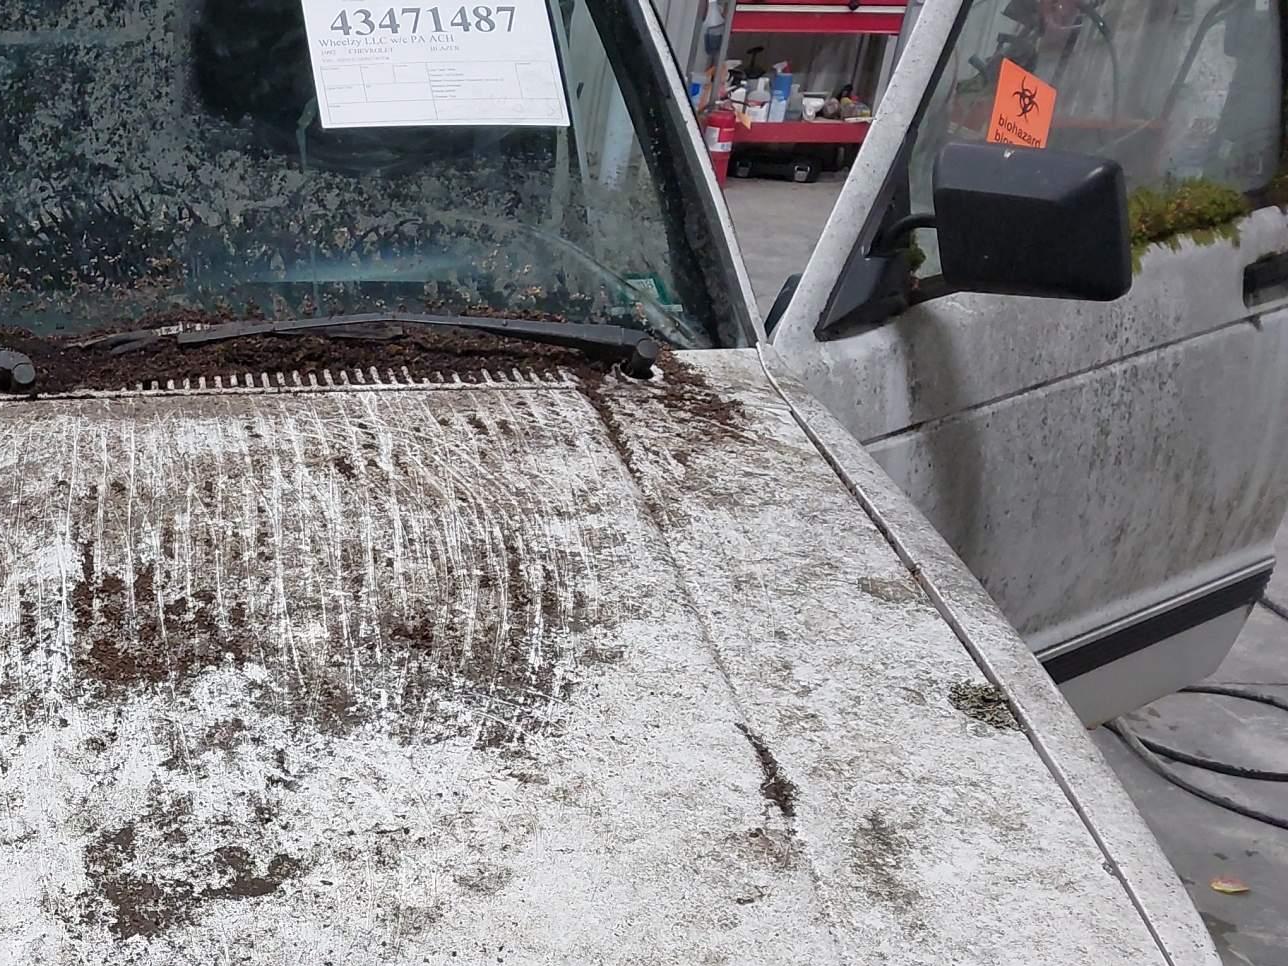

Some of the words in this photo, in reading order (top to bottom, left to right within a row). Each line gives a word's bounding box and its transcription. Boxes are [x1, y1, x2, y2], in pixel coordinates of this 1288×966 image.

[330, 6, 516, 36] 43471487
[318, 37, 362, 48] Wheelzy
[364, 36, 387, 46] LLC
[410, 34, 426, 44] PA
[429, 33, 455, 43] ACH
[998, 113, 1041, 148] biohazard
